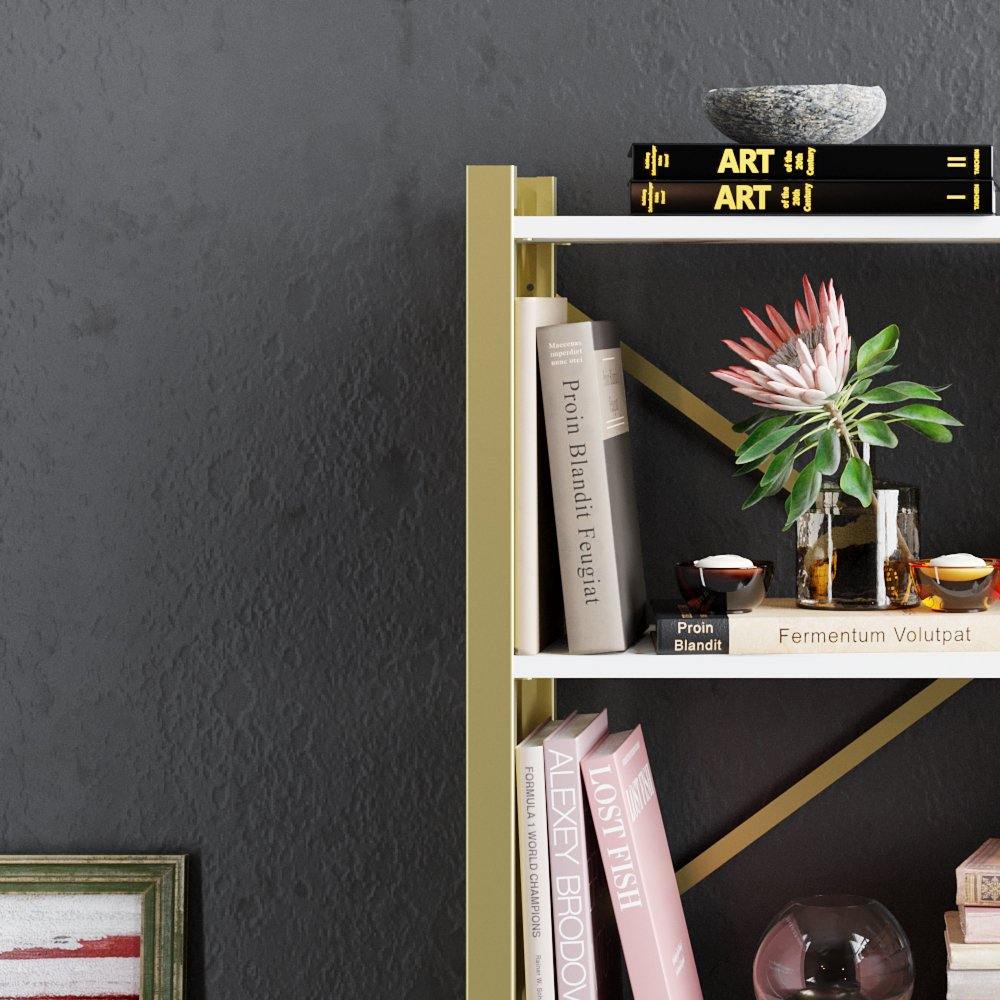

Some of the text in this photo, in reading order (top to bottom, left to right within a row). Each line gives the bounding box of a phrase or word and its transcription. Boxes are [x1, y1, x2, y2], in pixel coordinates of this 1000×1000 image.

[717, 148, 775, 173] ART
[806, 147, 817, 176] Century
[713, 184, 772, 210] ART
[803, 182, 814, 212] Century
[562, 379, 602, 606] Proin Blandit Feugiat
[677, 621, 714, 635] Proin
[779, 626, 972, 645] Fermentum Volutpat
[674, 638, 722, 652] Blandit
[524, 766, 536, 819] FORMULA
[548, 749, 580, 866] ALEXEY
[528, 831, 538, 871] WORLD
[588, 766, 643, 912] LOST FISH
[529, 873, 541, 938] CHAMPIONS
